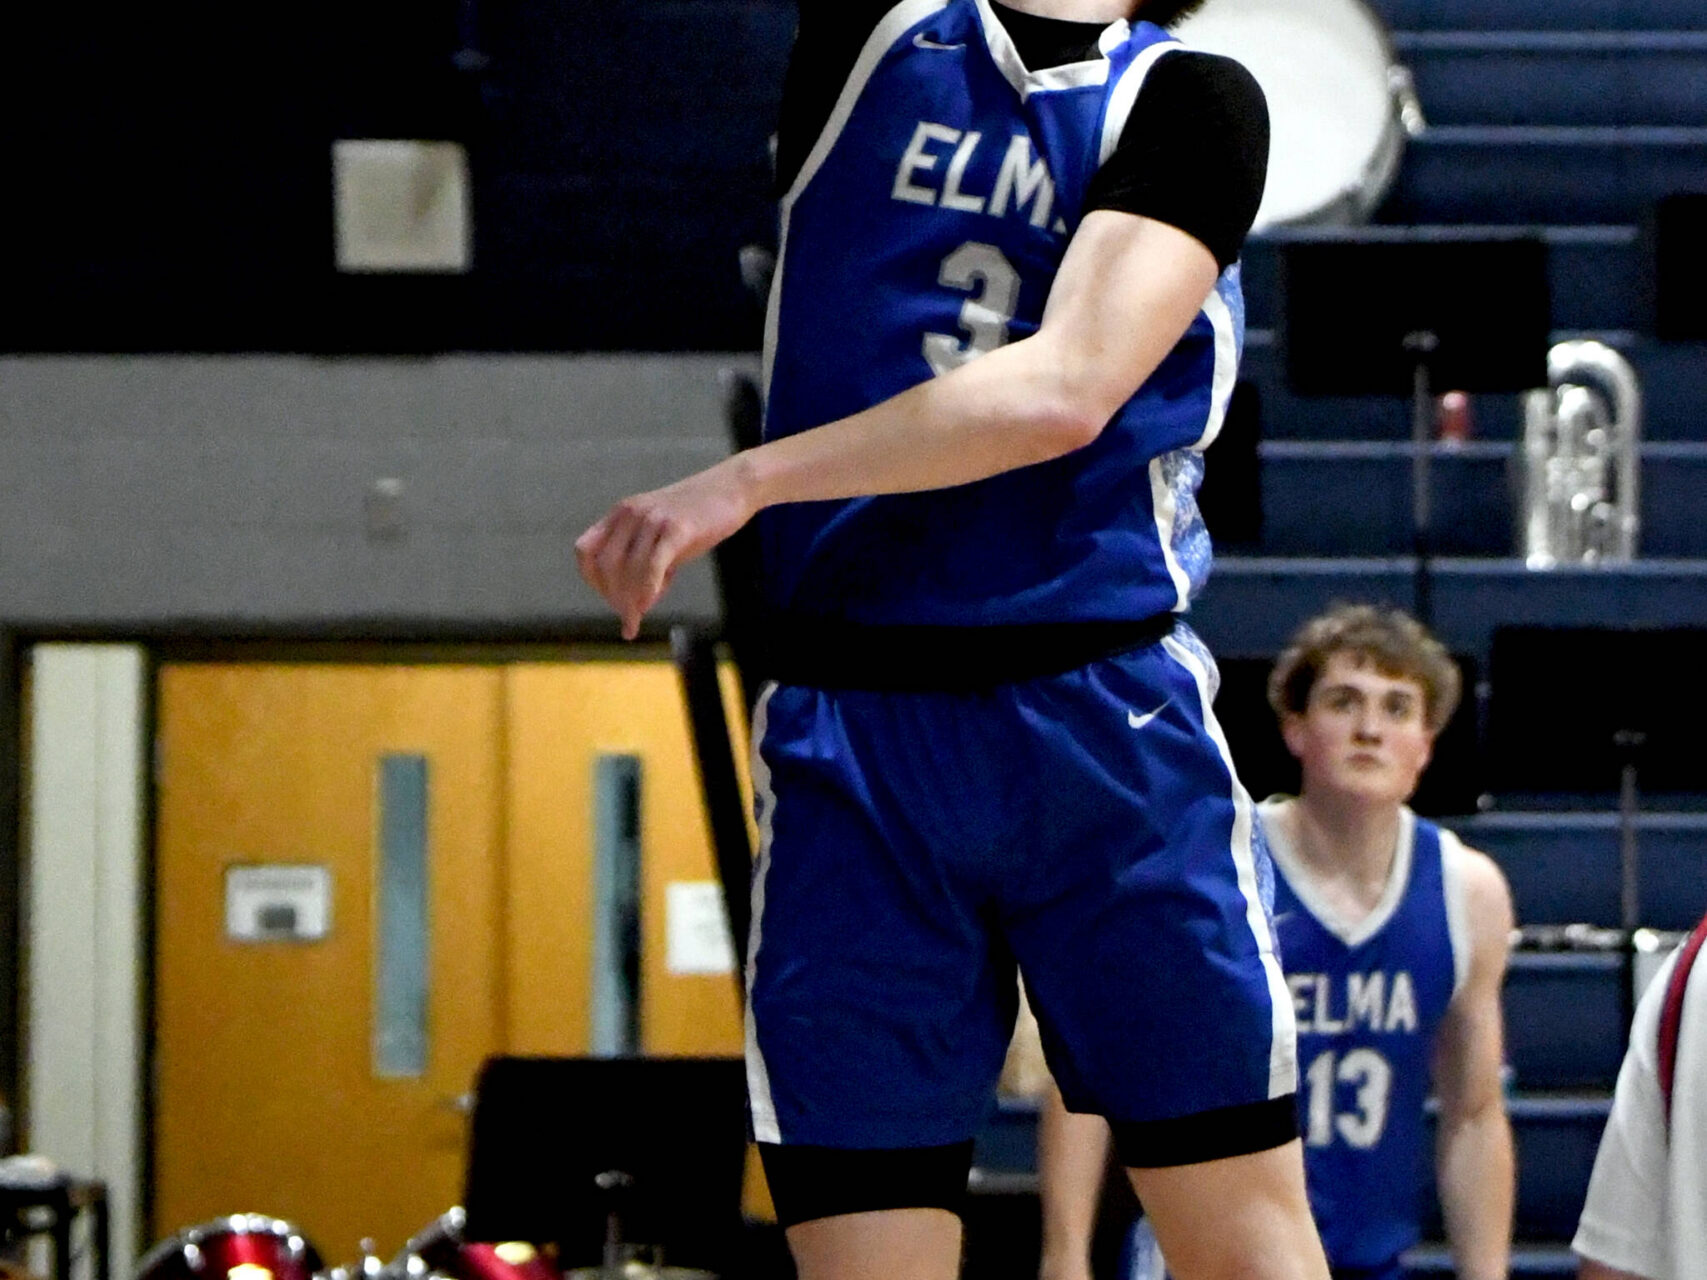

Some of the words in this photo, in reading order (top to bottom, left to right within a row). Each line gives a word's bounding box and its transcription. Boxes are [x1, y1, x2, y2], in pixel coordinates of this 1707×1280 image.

[891, 121, 1067, 236] ELM
[922, 240, 1022, 378] 3
[1285, 971, 1419, 1035] ELMA
[1306, 1047, 1390, 1149] 13
